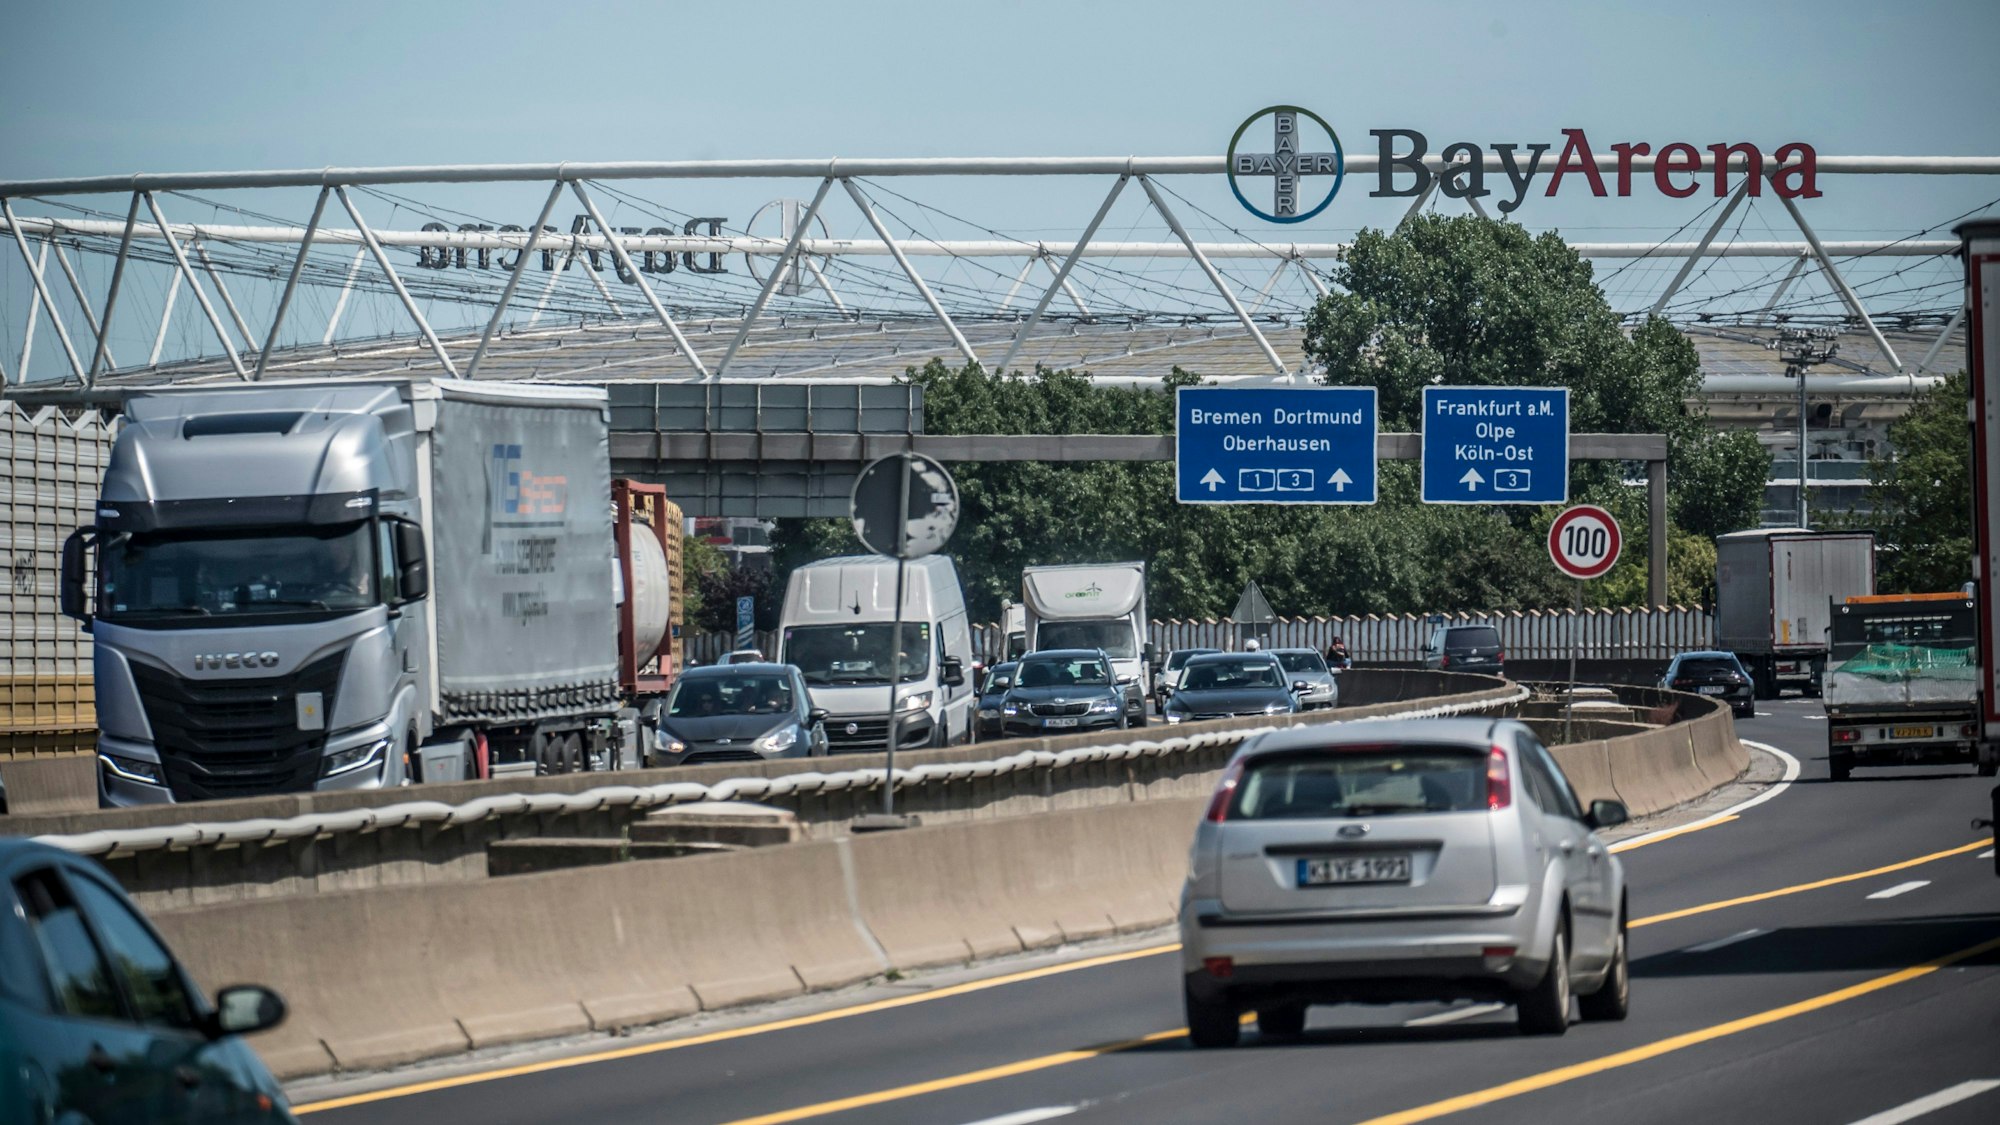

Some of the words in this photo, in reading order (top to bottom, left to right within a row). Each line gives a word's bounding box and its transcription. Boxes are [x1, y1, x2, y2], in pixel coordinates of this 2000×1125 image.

[1238, 156, 1333, 173] BAYER
[1276, 116, 1295, 214] BAYER
[1369, 129, 1823, 213] BayArena
[1436, 399, 1521, 416] Frankfurt
[1527, 400, 1554, 416] a.M.
[1191, 408, 1262, 425] Bremen
[1274, 408, 1362, 425] Dortmund
[1475, 422, 1515, 442] Olpe
[1223, 435, 1331, 451] Oberhausen
[1455, 444, 1533, 461] Köln-Ost
[1291, 473, 1301, 487] 3
[1508, 473, 1518, 487] 3
[1565, 525, 1606, 559] 100
[194, 651, 280, 671] IVECO
